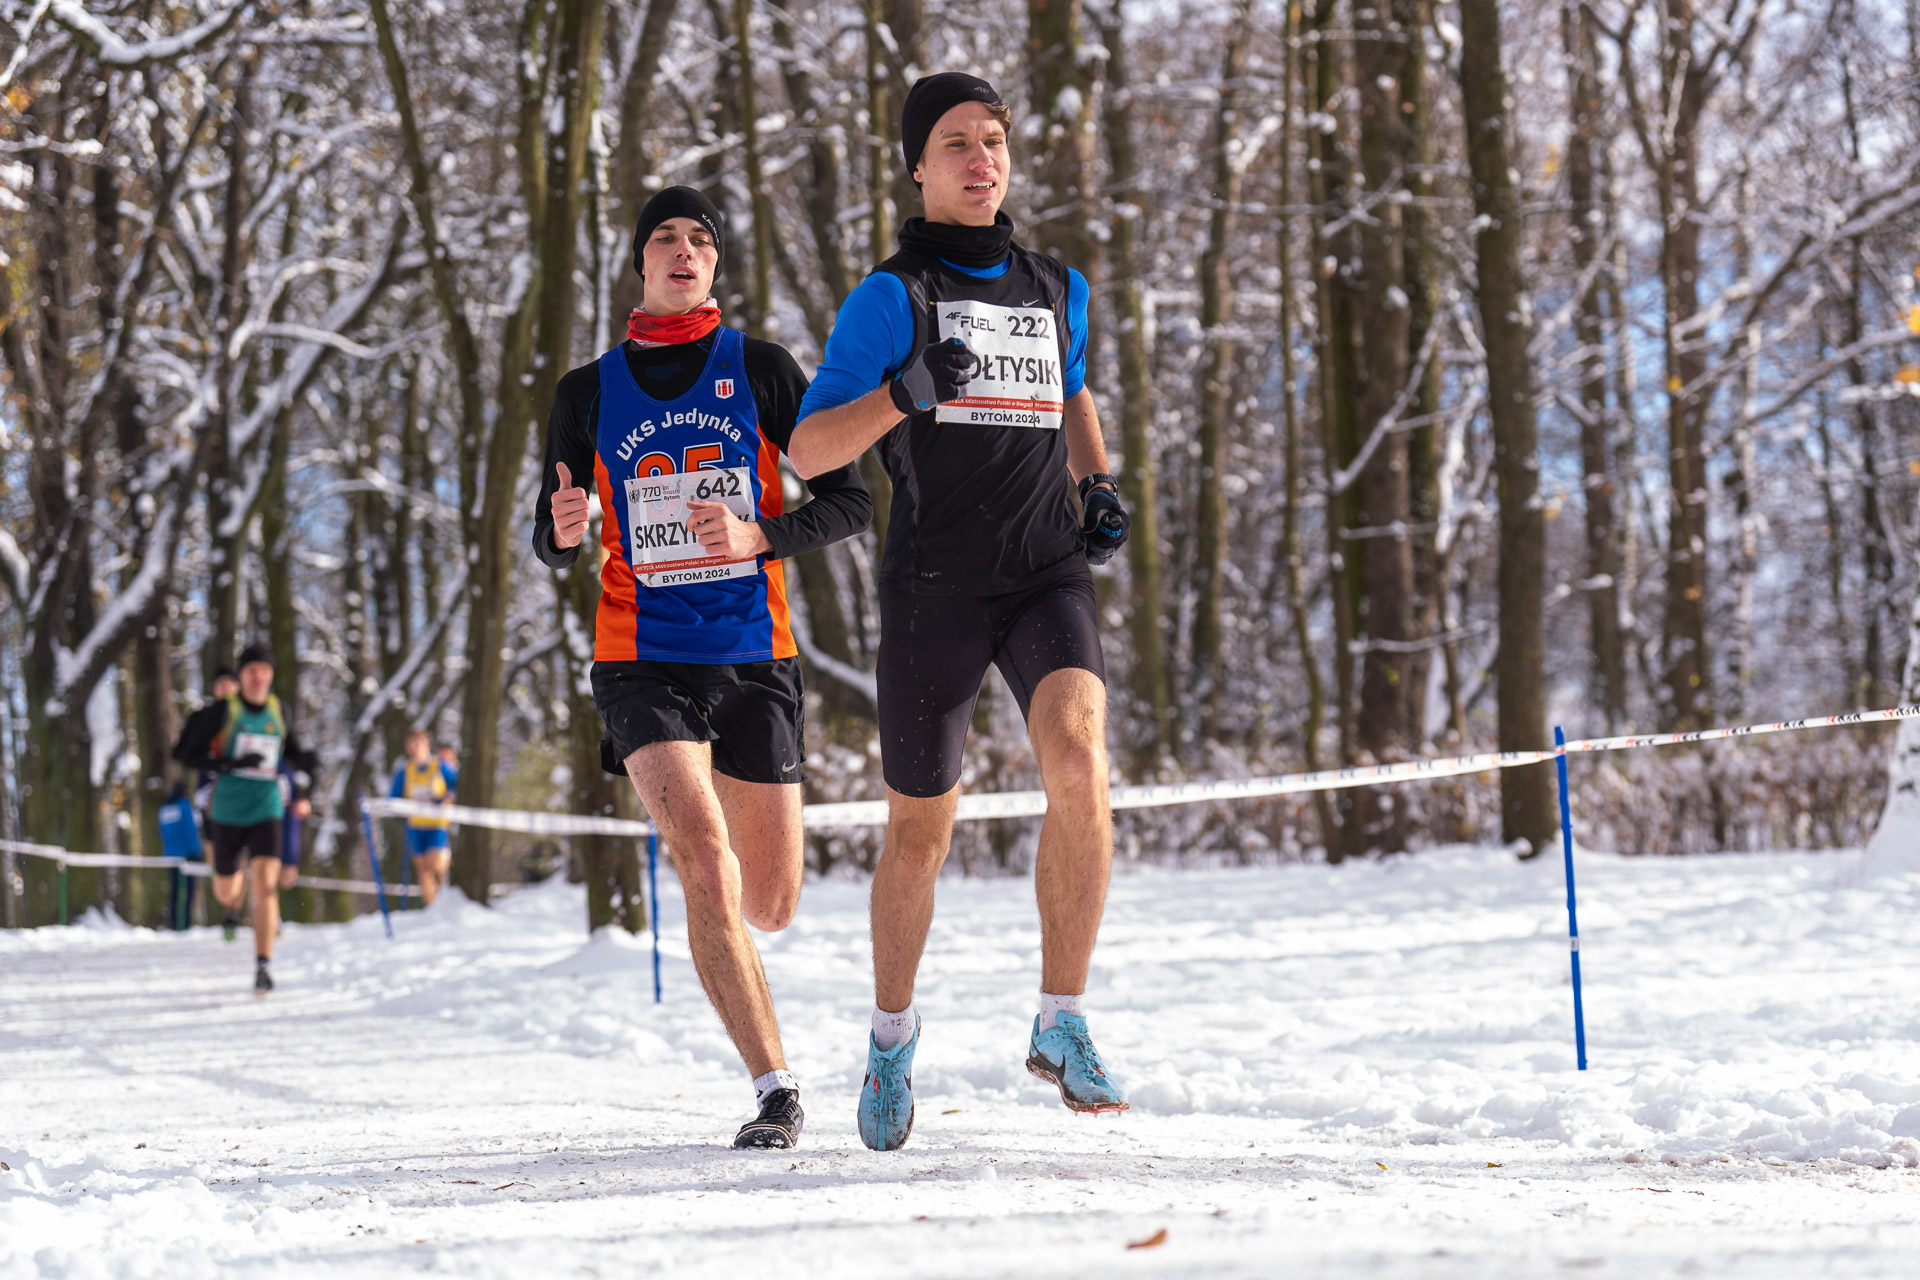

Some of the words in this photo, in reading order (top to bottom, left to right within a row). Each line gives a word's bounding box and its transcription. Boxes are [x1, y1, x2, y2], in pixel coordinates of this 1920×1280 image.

[961, 315, 996, 332] FUEL
[1007, 315, 1050, 339] 222
[971, 354, 1059, 386] OŁTYSIK
[965, 398, 997, 406] Mistrzostwa
[971, 411, 1013, 423] BYTOM
[1015, 413, 1041, 424] 2024
[616, 419, 656, 461] UKS
[661, 408, 742, 442] Jedynka
[641, 486, 661, 499] 770
[696, 475, 742, 500] 642
[655, 561, 684, 570] Mistrzostwa
[685, 559, 699, 567] Polski
[662, 571, 703, 584] BYTOM
[705, 568, 731, 579] 2024
